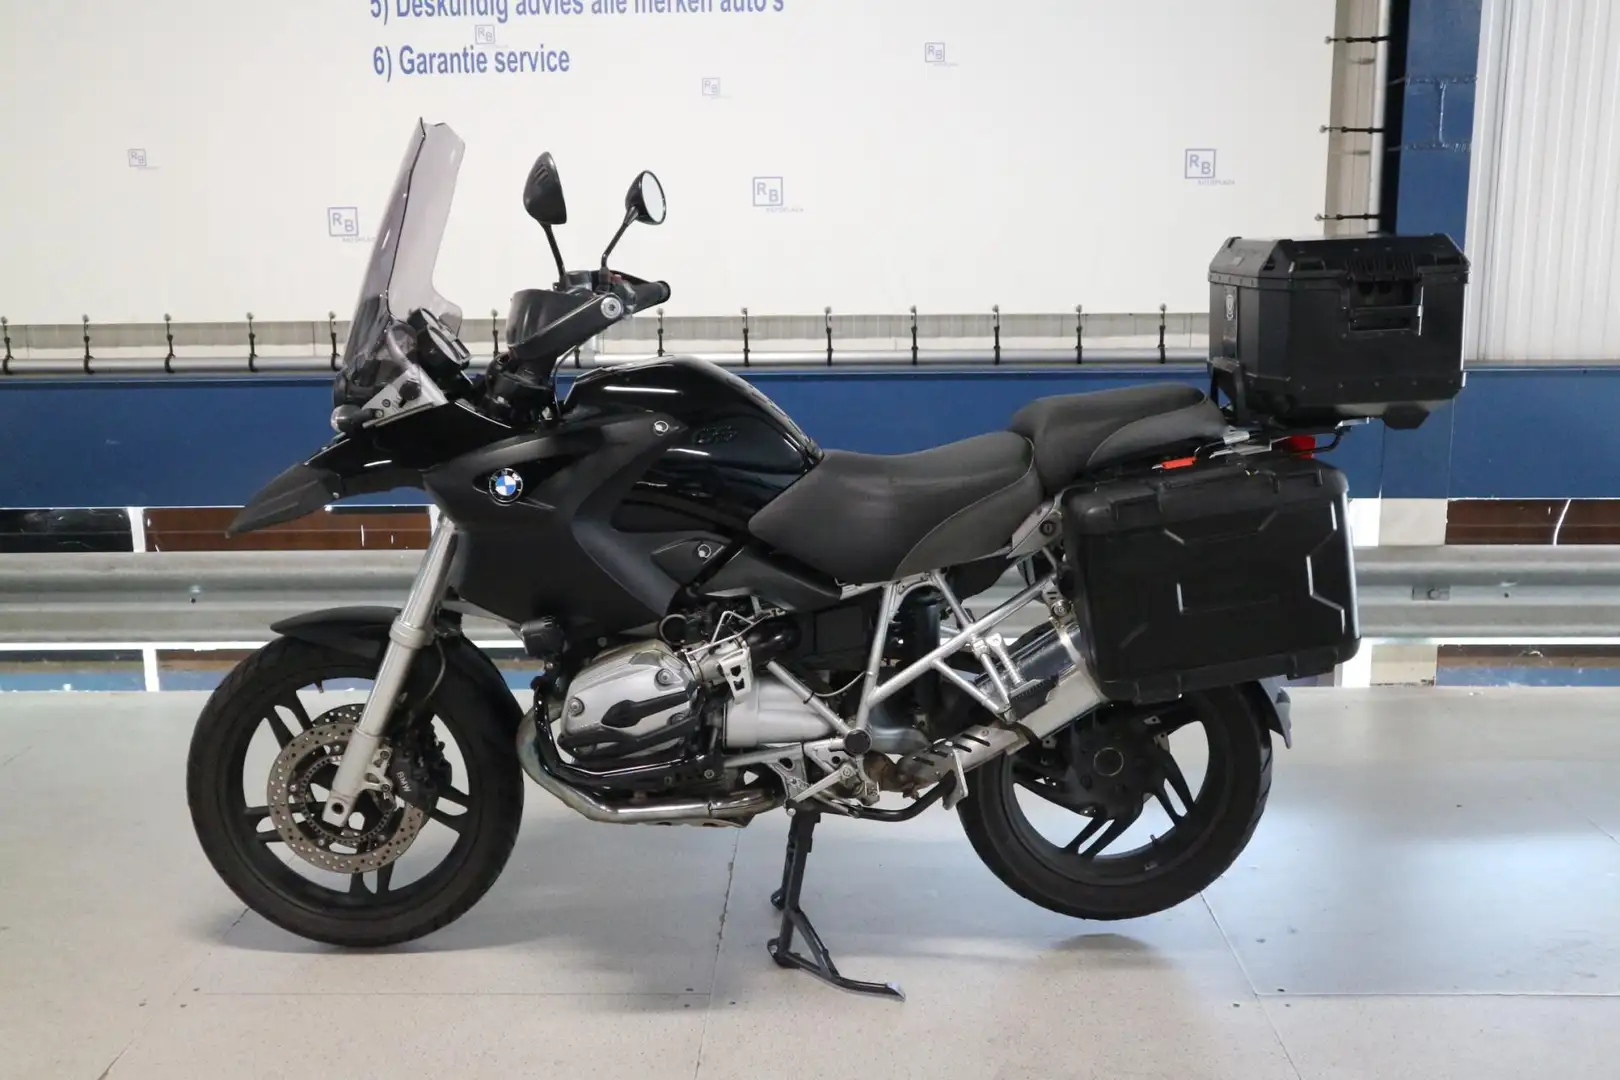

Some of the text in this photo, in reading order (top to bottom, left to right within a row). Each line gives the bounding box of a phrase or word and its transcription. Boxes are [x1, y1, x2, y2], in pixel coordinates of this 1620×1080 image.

[370, 0, 389, 24] 5)
[396, 0, 509, 23] Deskundig
[515, 0, 584, 15] advies
[634, 0, 713, 13] merken
[720, 0, 785, 12] autos
[372, 44, 570, 83] 6) Garantie service
[395, 771, 412, 792] BMW
